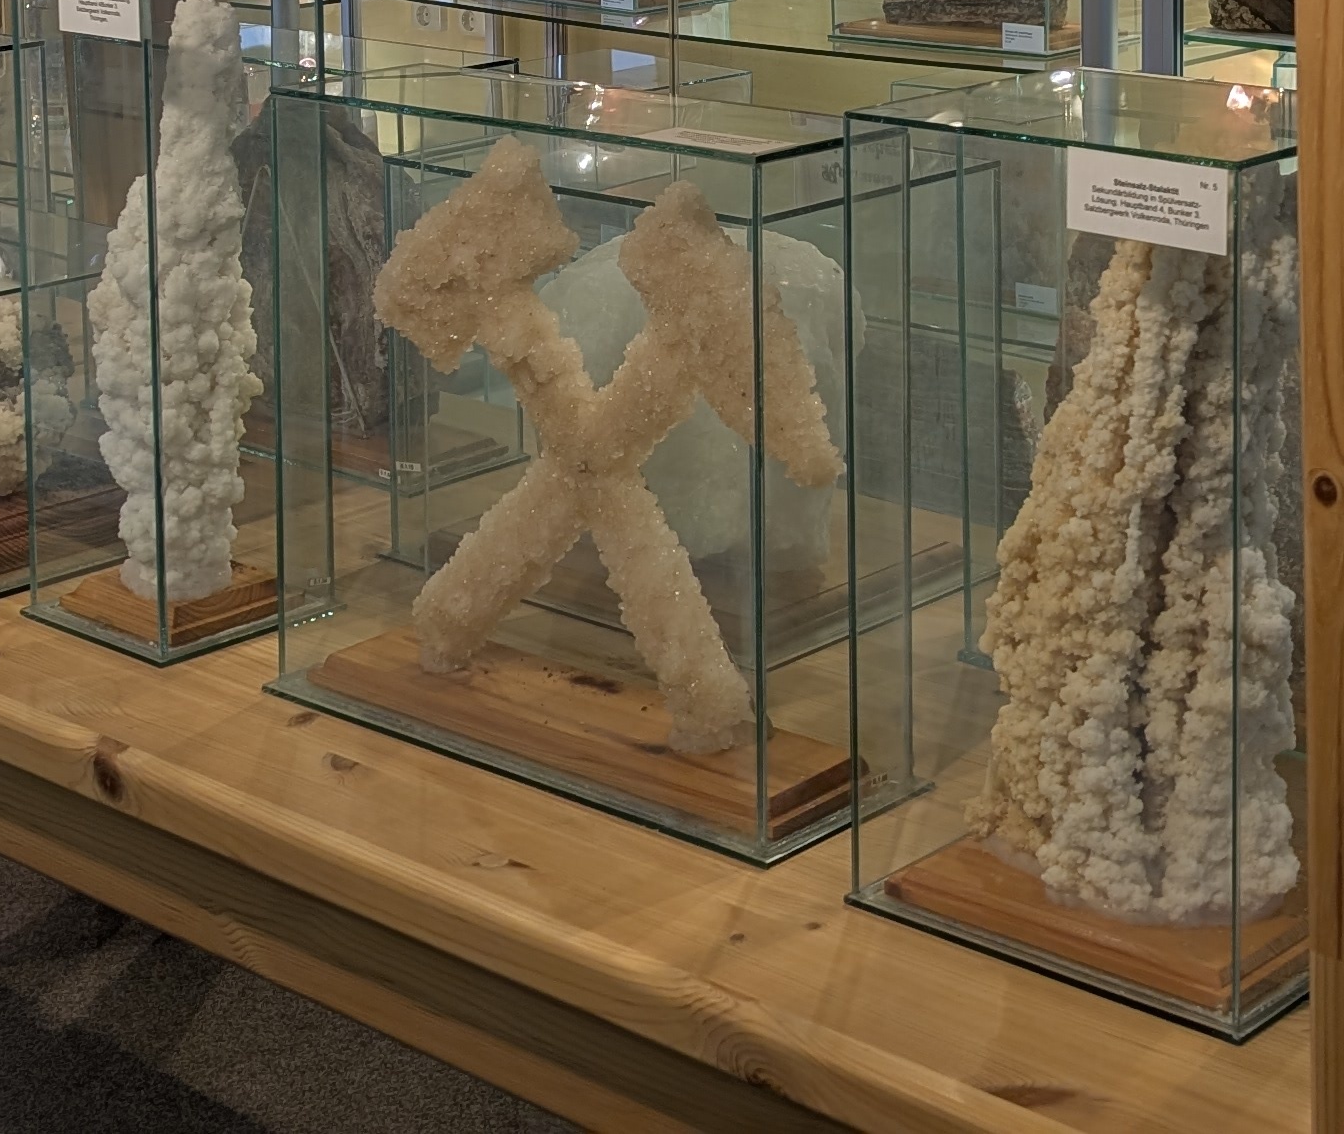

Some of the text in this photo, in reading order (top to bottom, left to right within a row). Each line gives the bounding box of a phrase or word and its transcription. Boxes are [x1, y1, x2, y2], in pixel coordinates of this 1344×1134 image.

[1084, 203, 1130, 217] Salzbergwerk
[1173, 218, 1210, 230] Thüringen
[1168, 206, 1192, 218] Bunker
